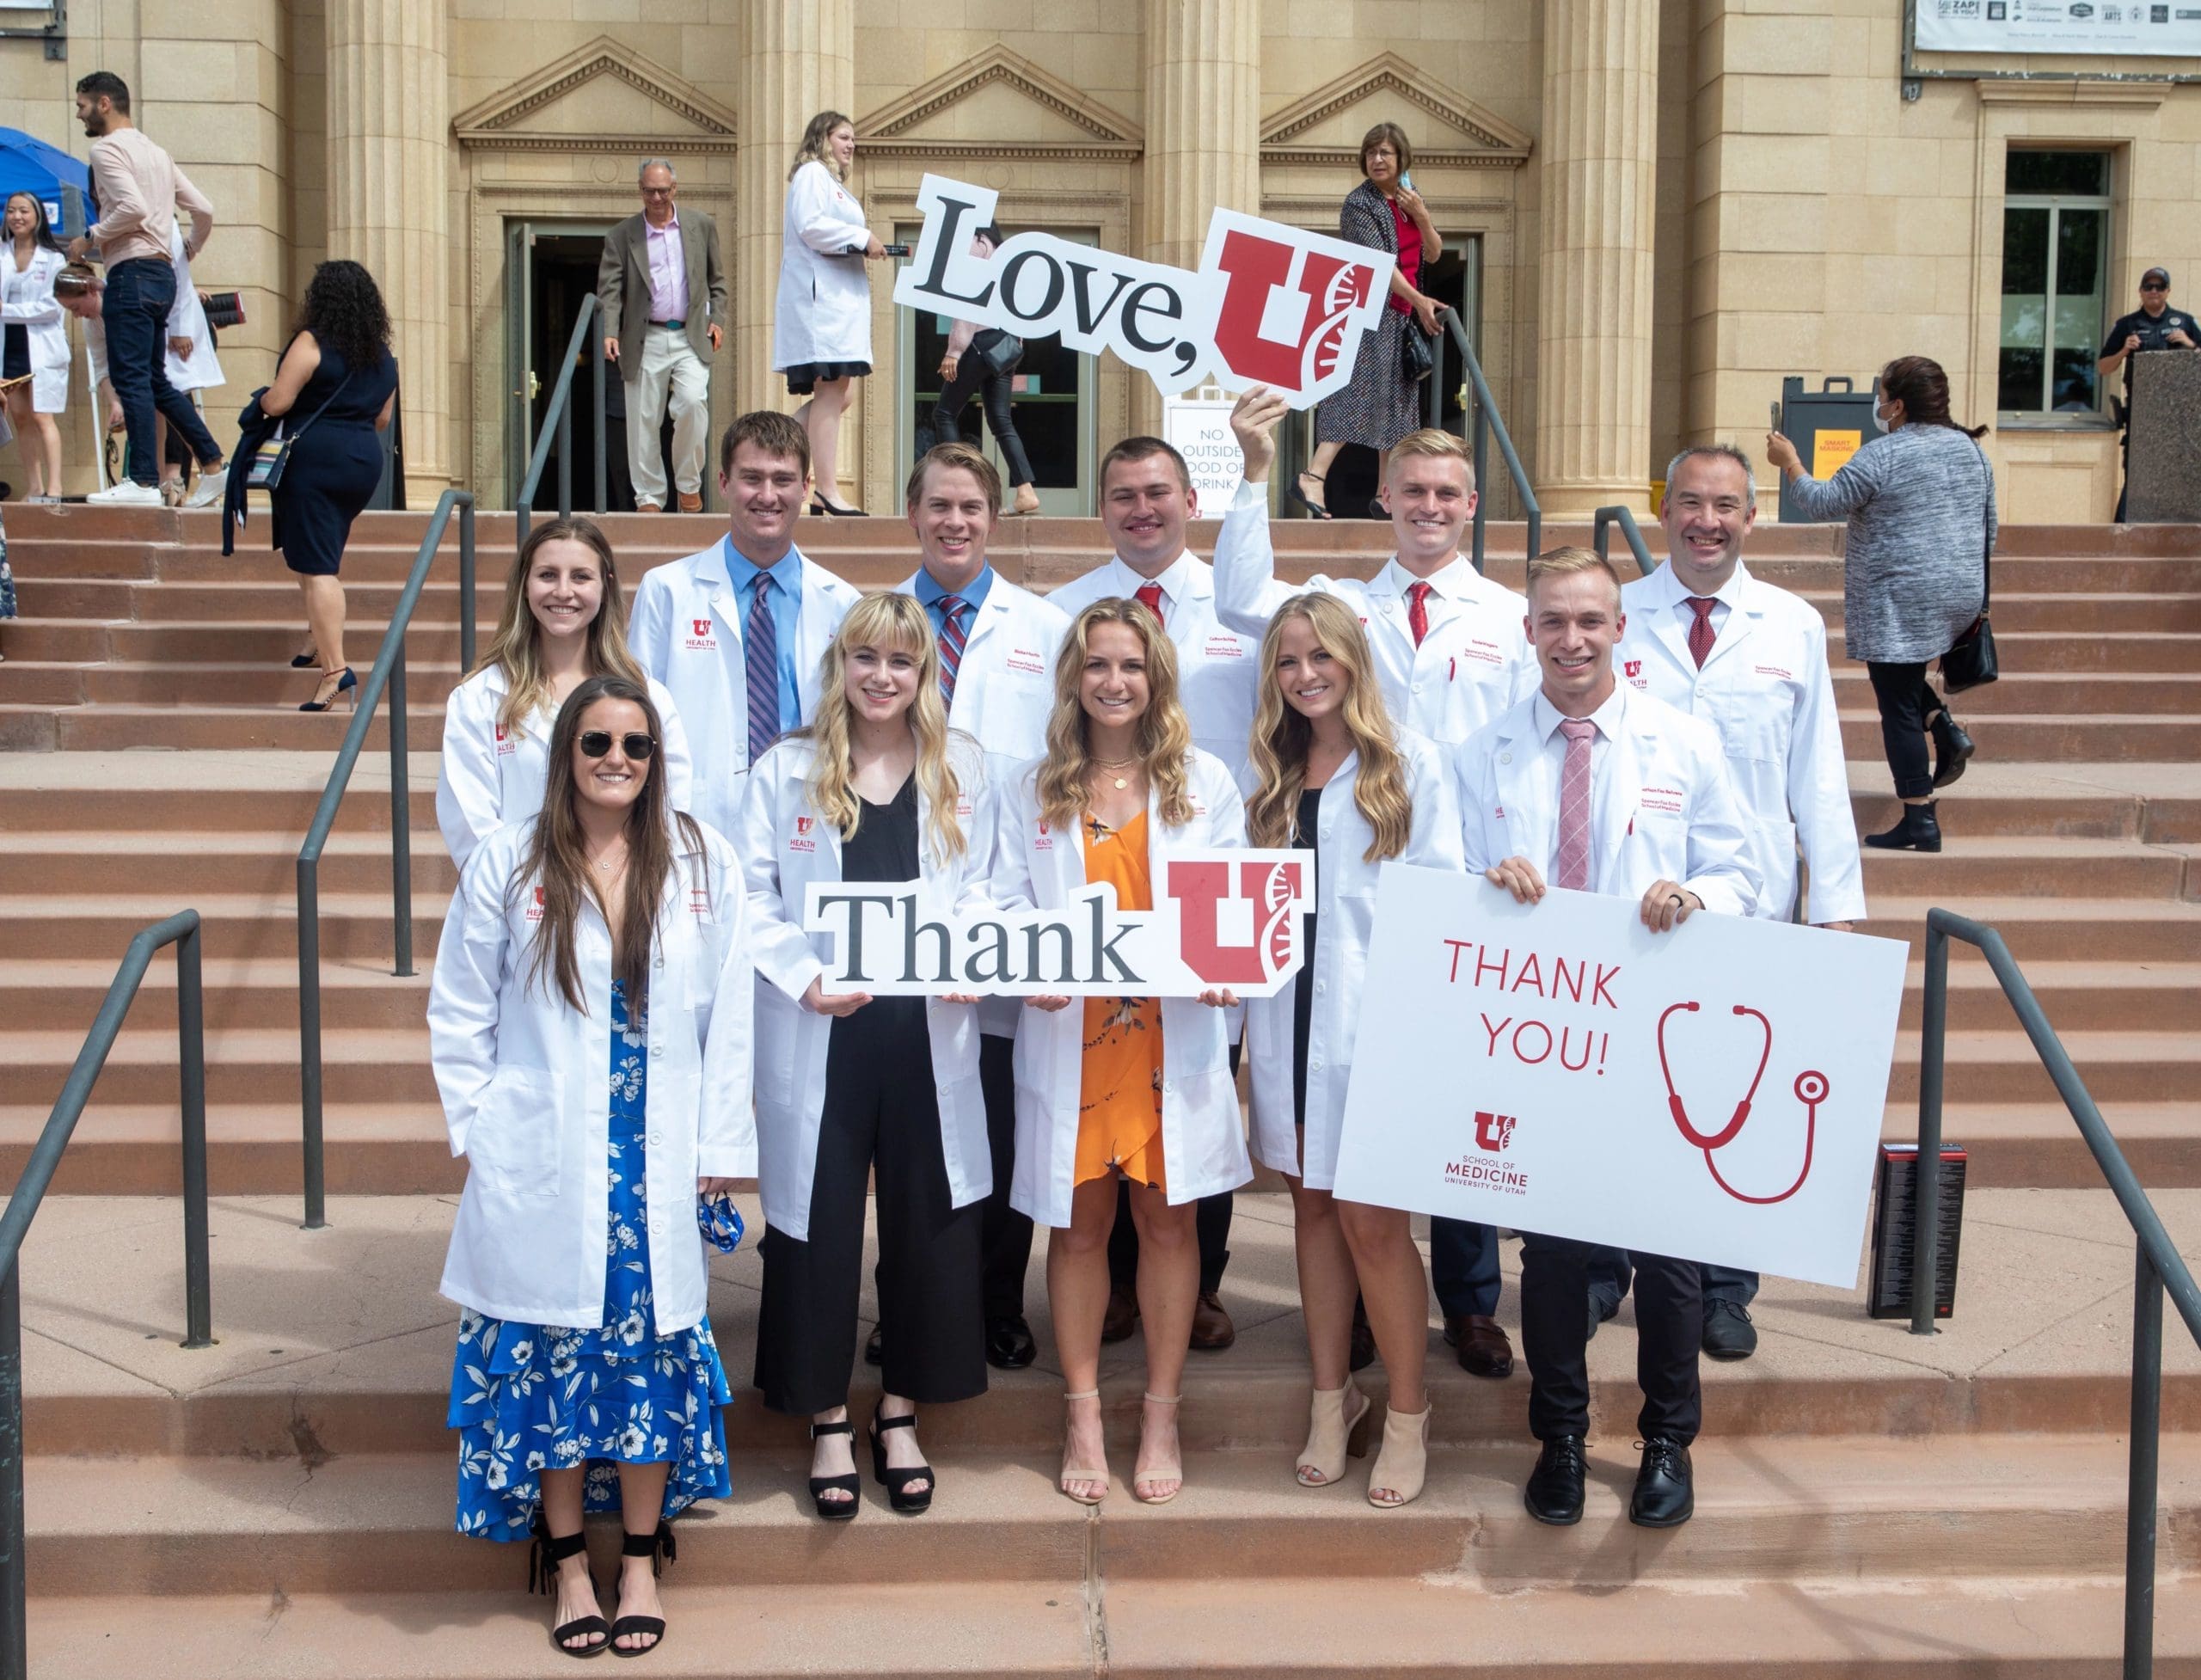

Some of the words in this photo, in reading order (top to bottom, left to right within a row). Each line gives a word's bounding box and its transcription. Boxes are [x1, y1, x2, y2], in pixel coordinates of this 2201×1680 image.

[913, 195, 1197, 377] Love,
[1214, 230, 1375, 392] U
[1200, 429, 1223, 440] NO
[1183, 445, 1241, 457] OUTSIDE
[1187, 462, 1222, 474] OOD
[1191, 478, 1234, 489] DRINK
[790, 839, 815, 848] HEALTH
[818, 894, 1147, 984] Thank
[1168, 861, 1301, 984] U
[1444, 939, 1621, 1009] THANK
[1481, 1013, 1609, 1075] YOU!
[1462, 1156, 1499, 1168] SCHOOL
[1445, 1162, 1528, 1186] MEDICINE
[1444, 1176, 1490, 1189] UNIVERSITY
[1505, 1186, 1526, 1195] UTAH
